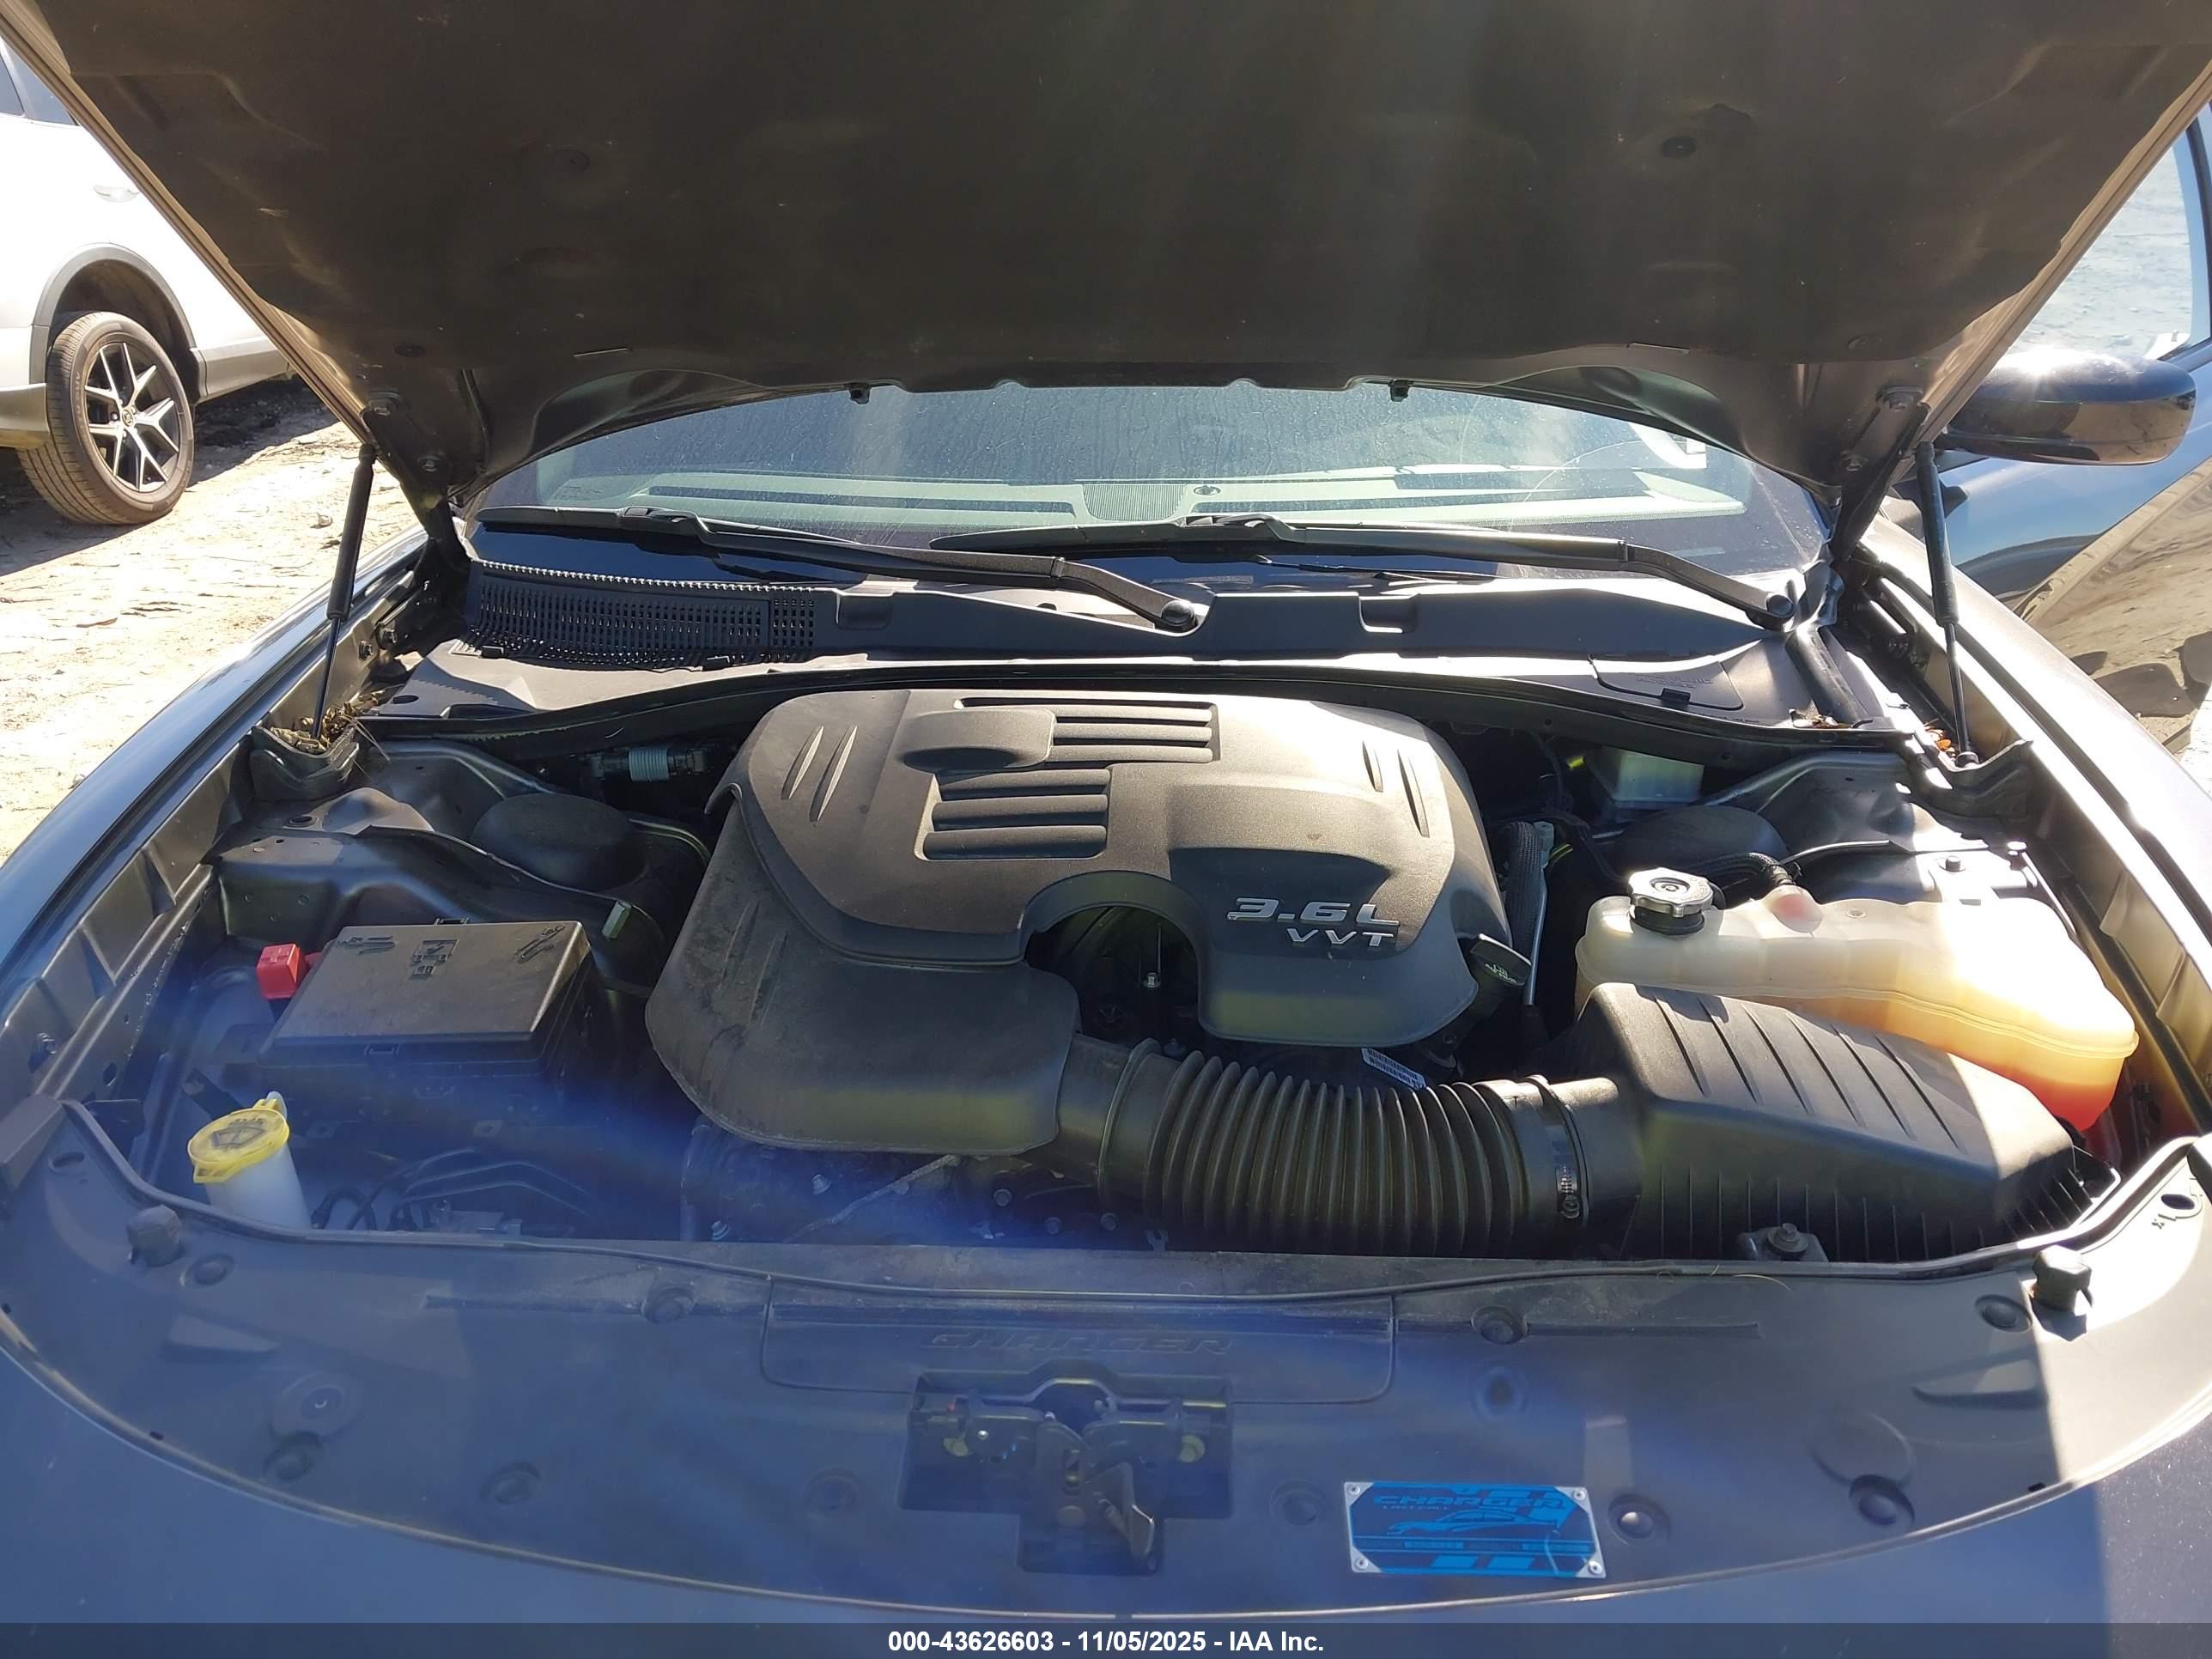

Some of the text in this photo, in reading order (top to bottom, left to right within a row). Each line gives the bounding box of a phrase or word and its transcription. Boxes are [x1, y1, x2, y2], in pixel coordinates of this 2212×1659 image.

[1227, 897, 1400, 926] 3.6L
[1287, 927, 1395, 947] VVT
[921, 1332, 1233, 1356] CHARGER
[1375, 1494, 1569, 1510] CHARGER
